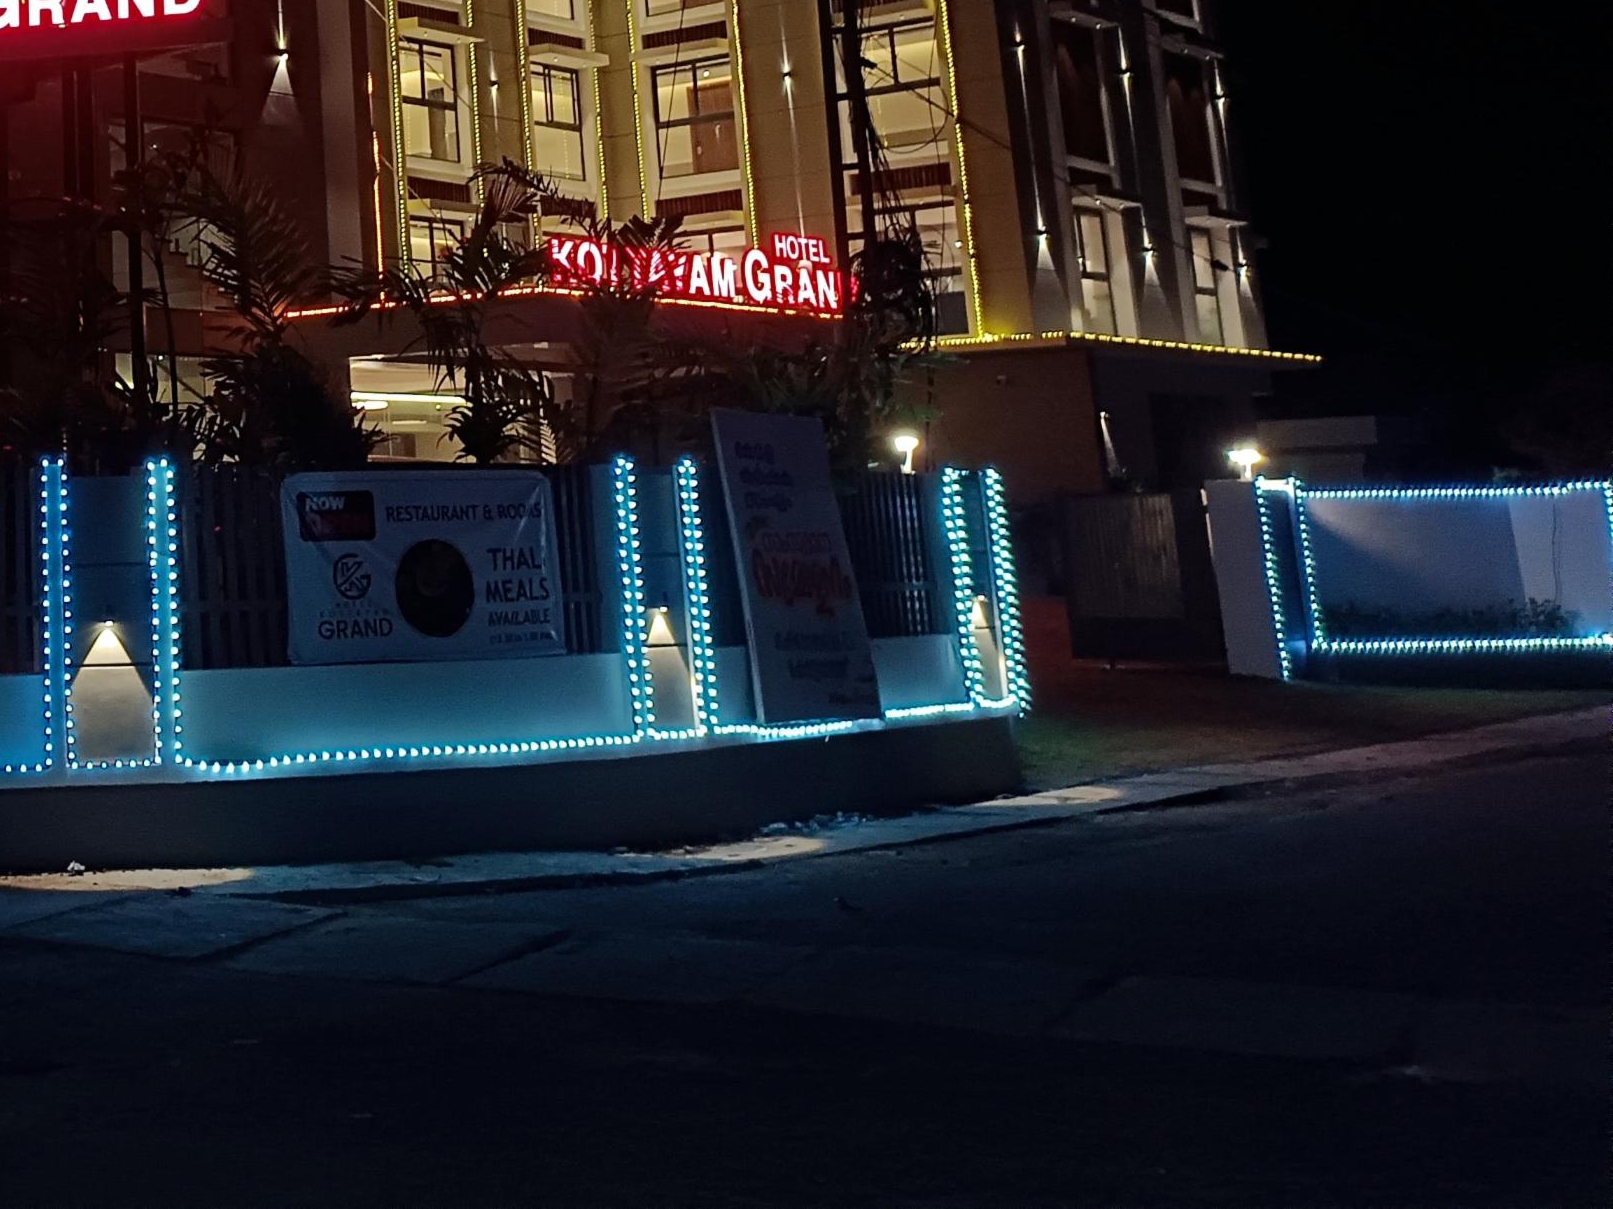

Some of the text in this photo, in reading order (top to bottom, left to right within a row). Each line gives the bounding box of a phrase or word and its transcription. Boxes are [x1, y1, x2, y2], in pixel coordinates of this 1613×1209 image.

[774, 233, 831, 265] HOTEL
[305, 494, 346, 511] NOW
[385, 503, 478, 523] RESTAURANT
[483, 504, 492, 521] &
[486, 577, 550, 603] MEALS
[488, 608, 551, 627] AVAILABLE
[318, 618, 393, 640] GRAND
